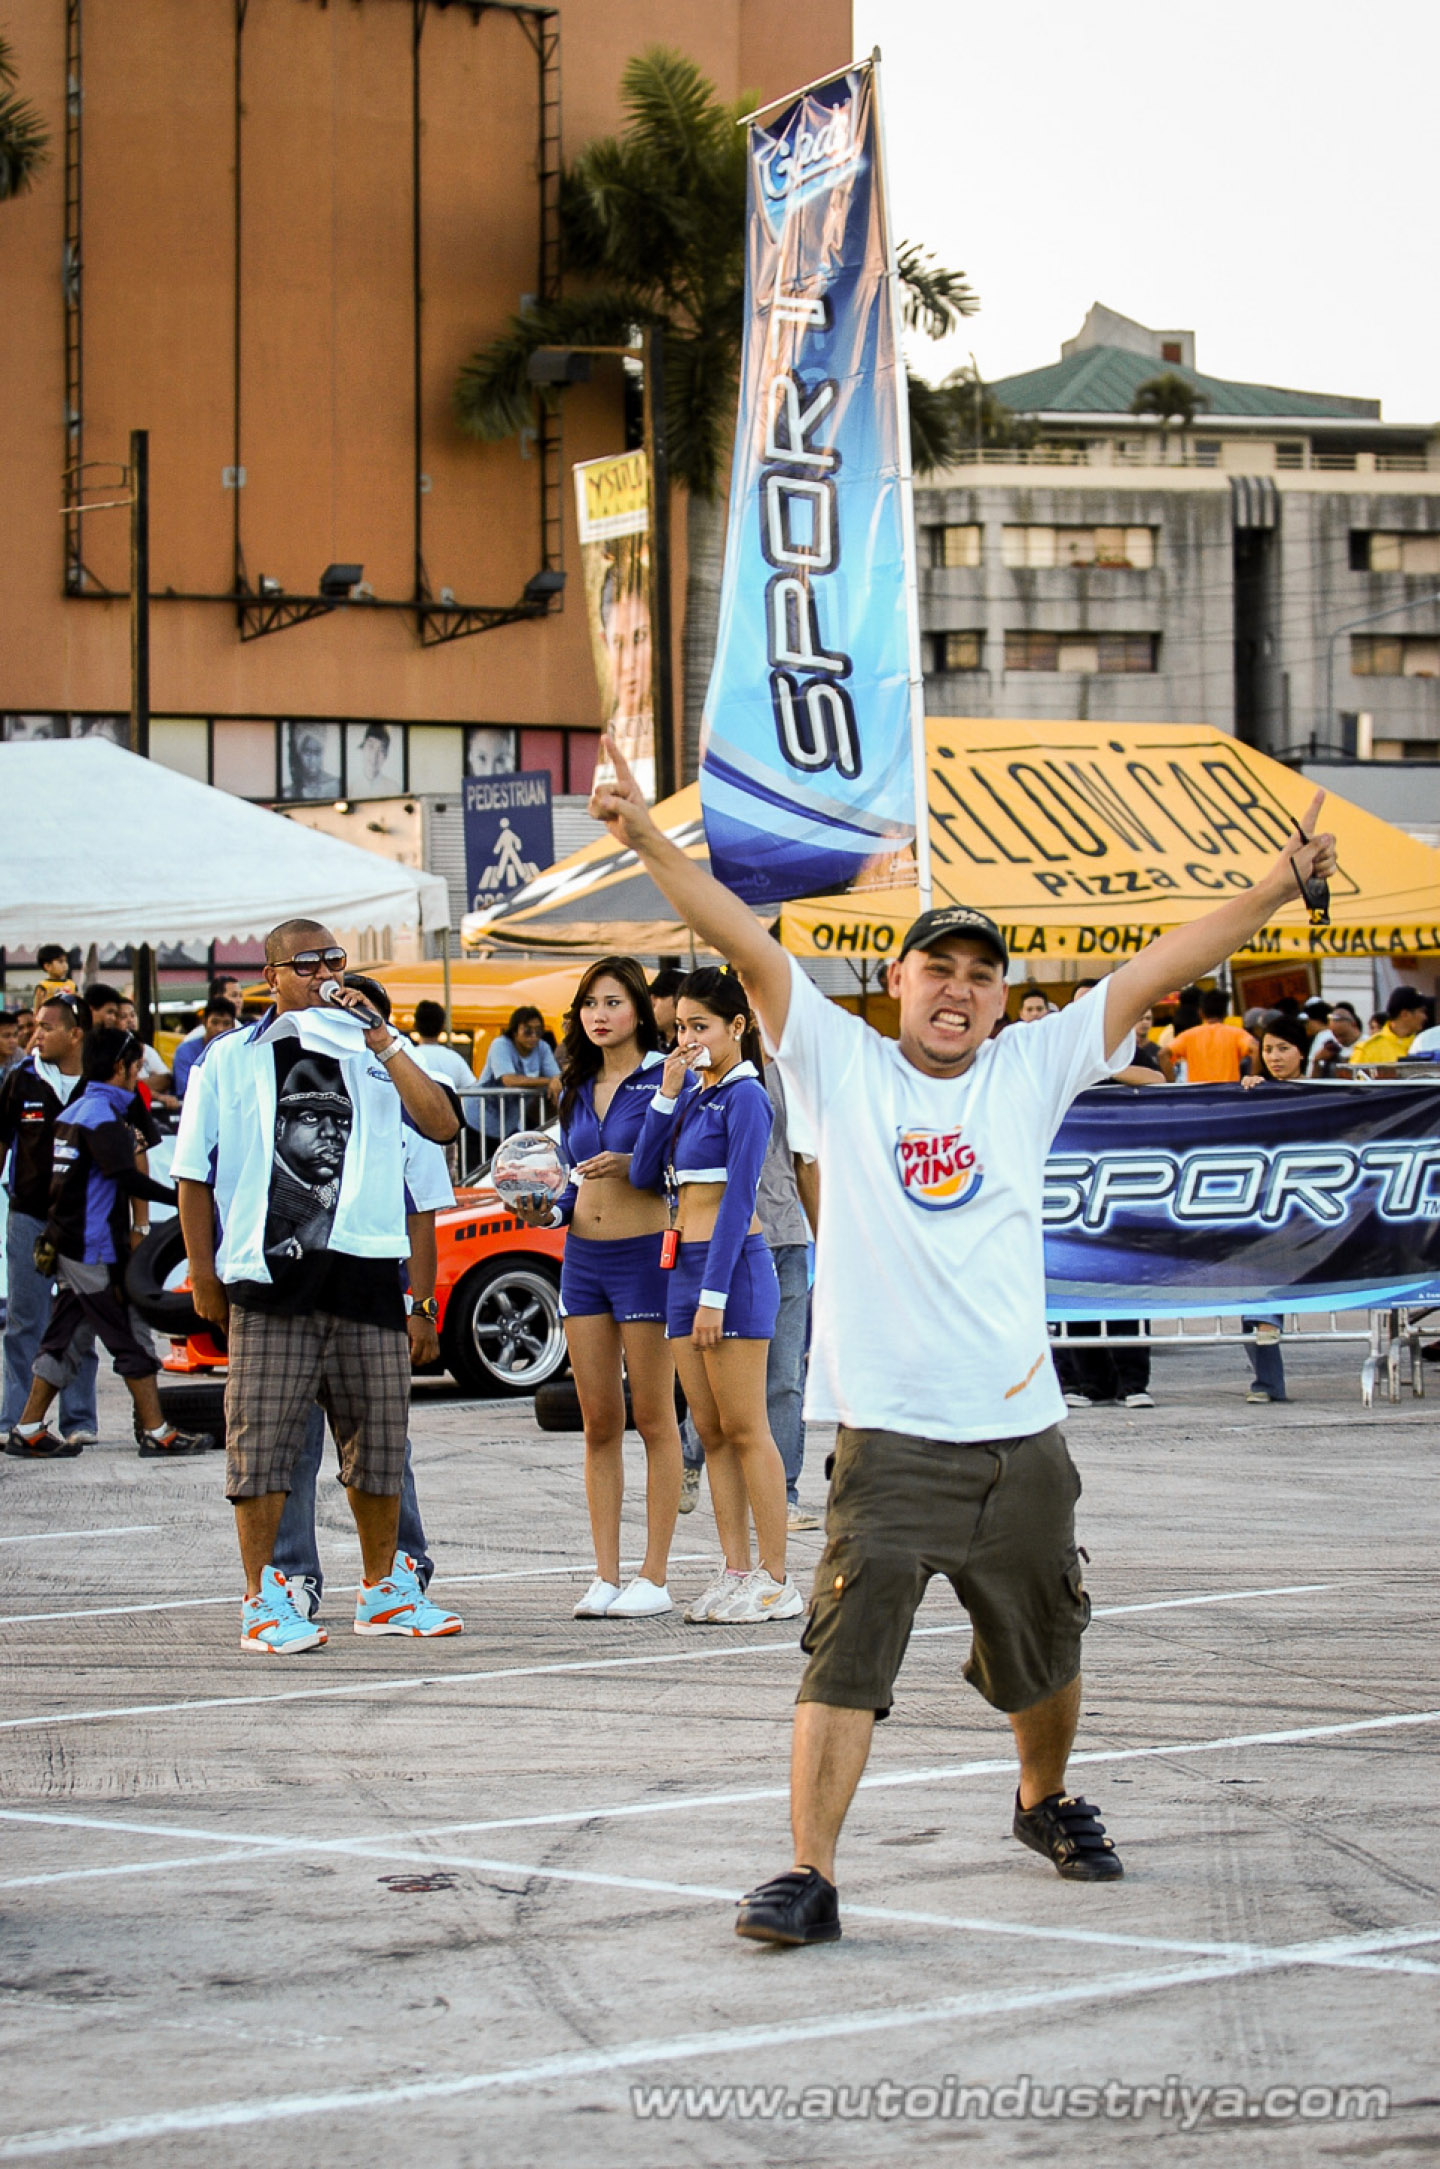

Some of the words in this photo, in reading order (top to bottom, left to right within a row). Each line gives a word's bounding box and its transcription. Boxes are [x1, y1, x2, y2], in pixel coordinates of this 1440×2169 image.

[763, 256, 857, 776] SPORT
[467, 779, 547, 811] PEDESTRIAN
[929, 759, 1167, 864] ELLOW
[1032, 867, 1181, 897] Pizza
[812, 923, 895, 952] OHIO
[1309, 927, 1407, 953] KUALA
[904, 1145, 976, 1187] KING
